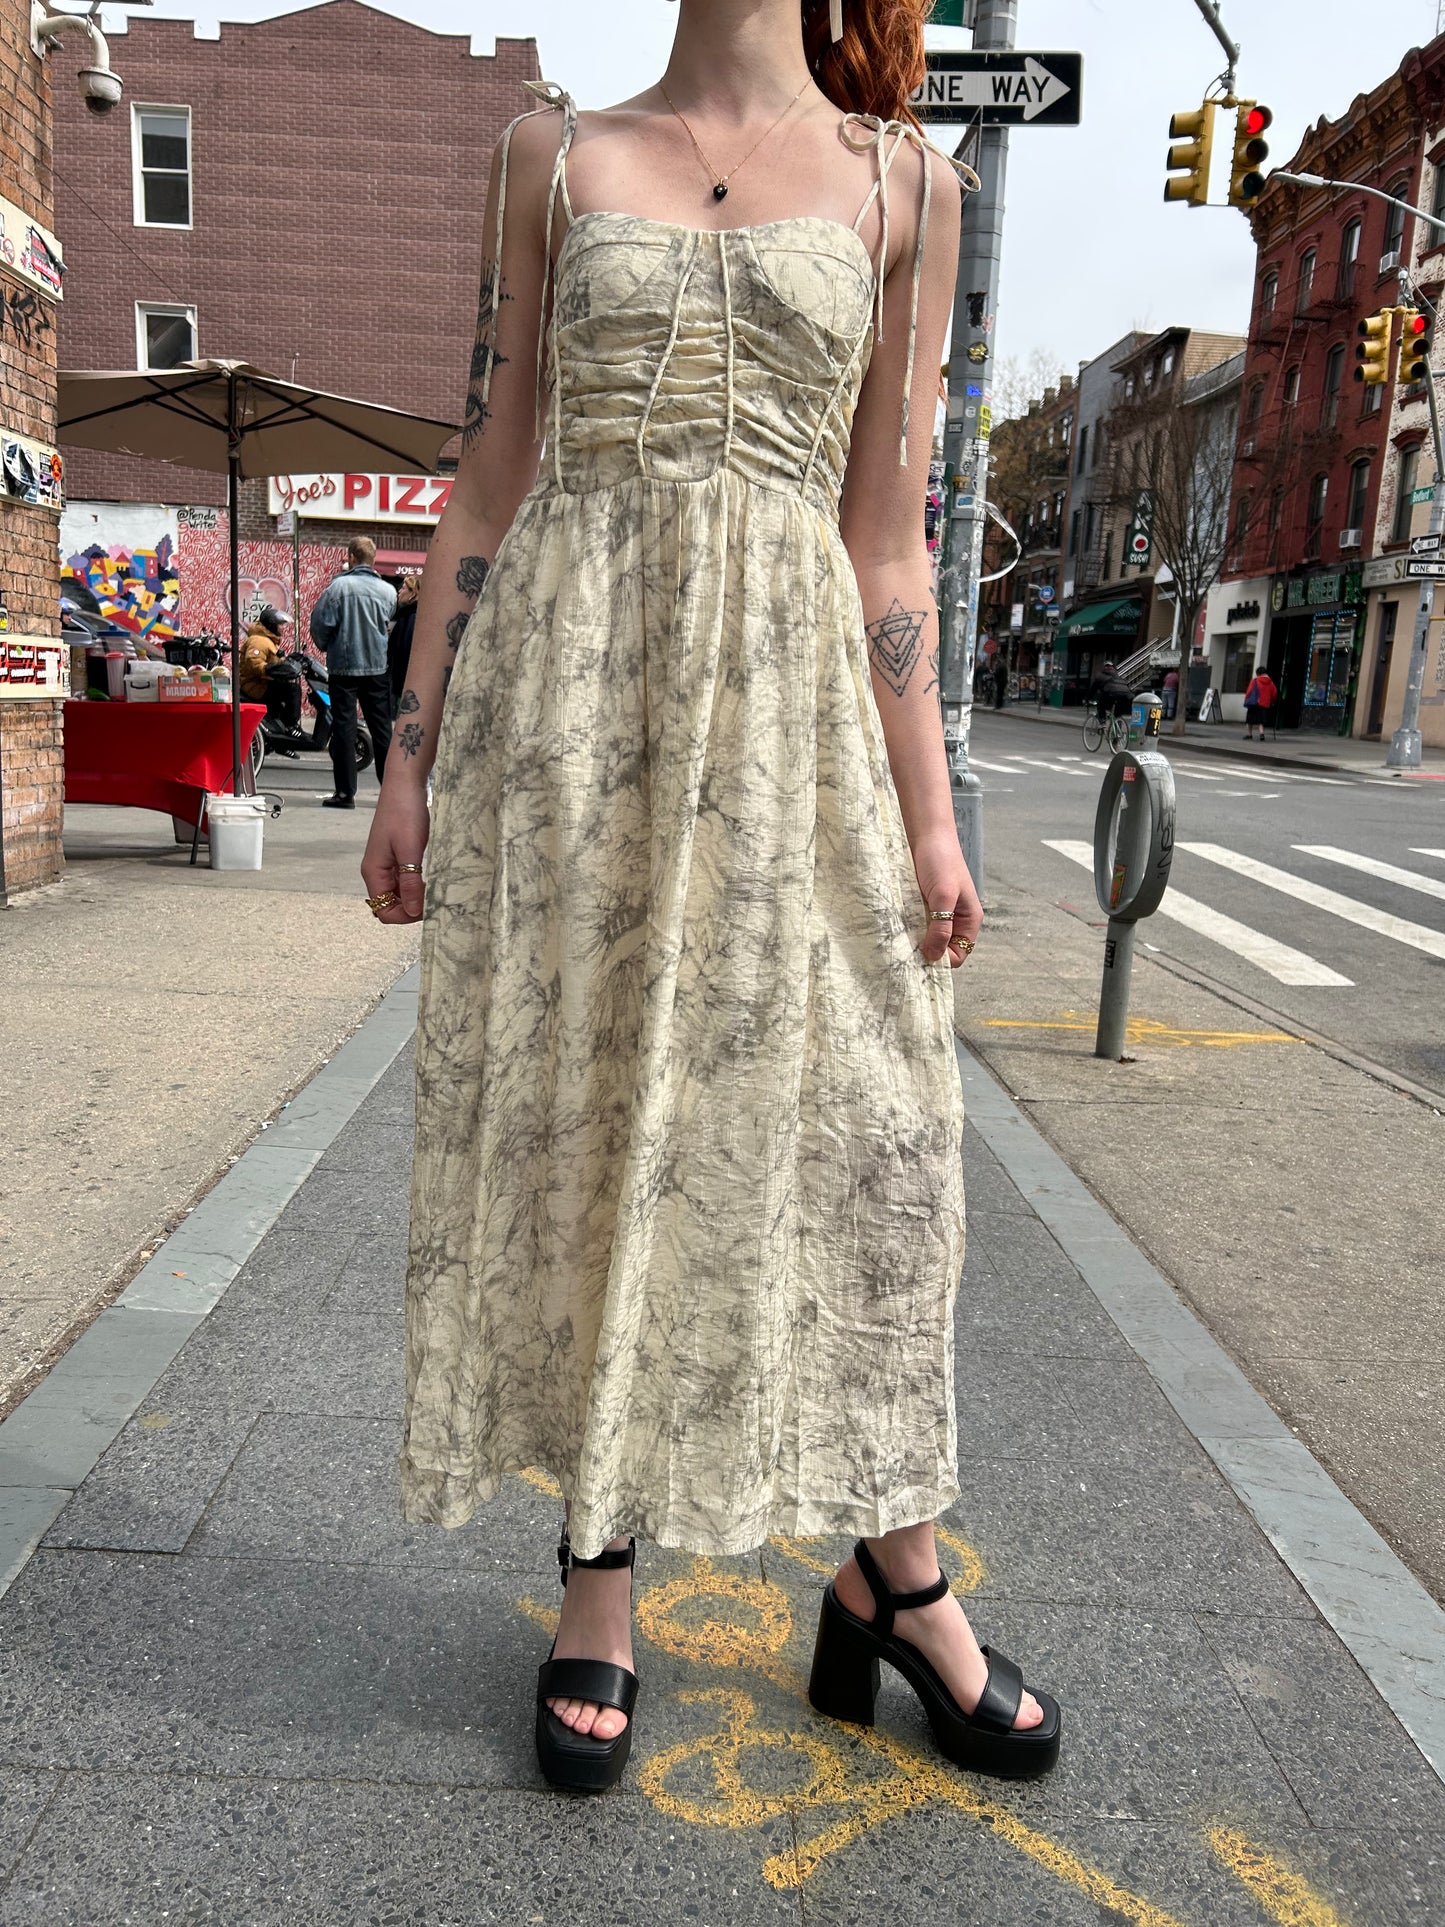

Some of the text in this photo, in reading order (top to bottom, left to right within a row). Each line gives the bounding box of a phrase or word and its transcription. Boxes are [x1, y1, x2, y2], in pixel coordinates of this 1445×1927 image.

[992, 75, 1051, 103] WAY
[274, 474, 337, 511] Joe's
[395, 566, 423, 576] JOE'S
[1413, 565, 1431, 574] ONE
[252, 590, 264, 602] I
[243, 599, 273, 611] Love
[165, 686, 197, 697] MANGO
